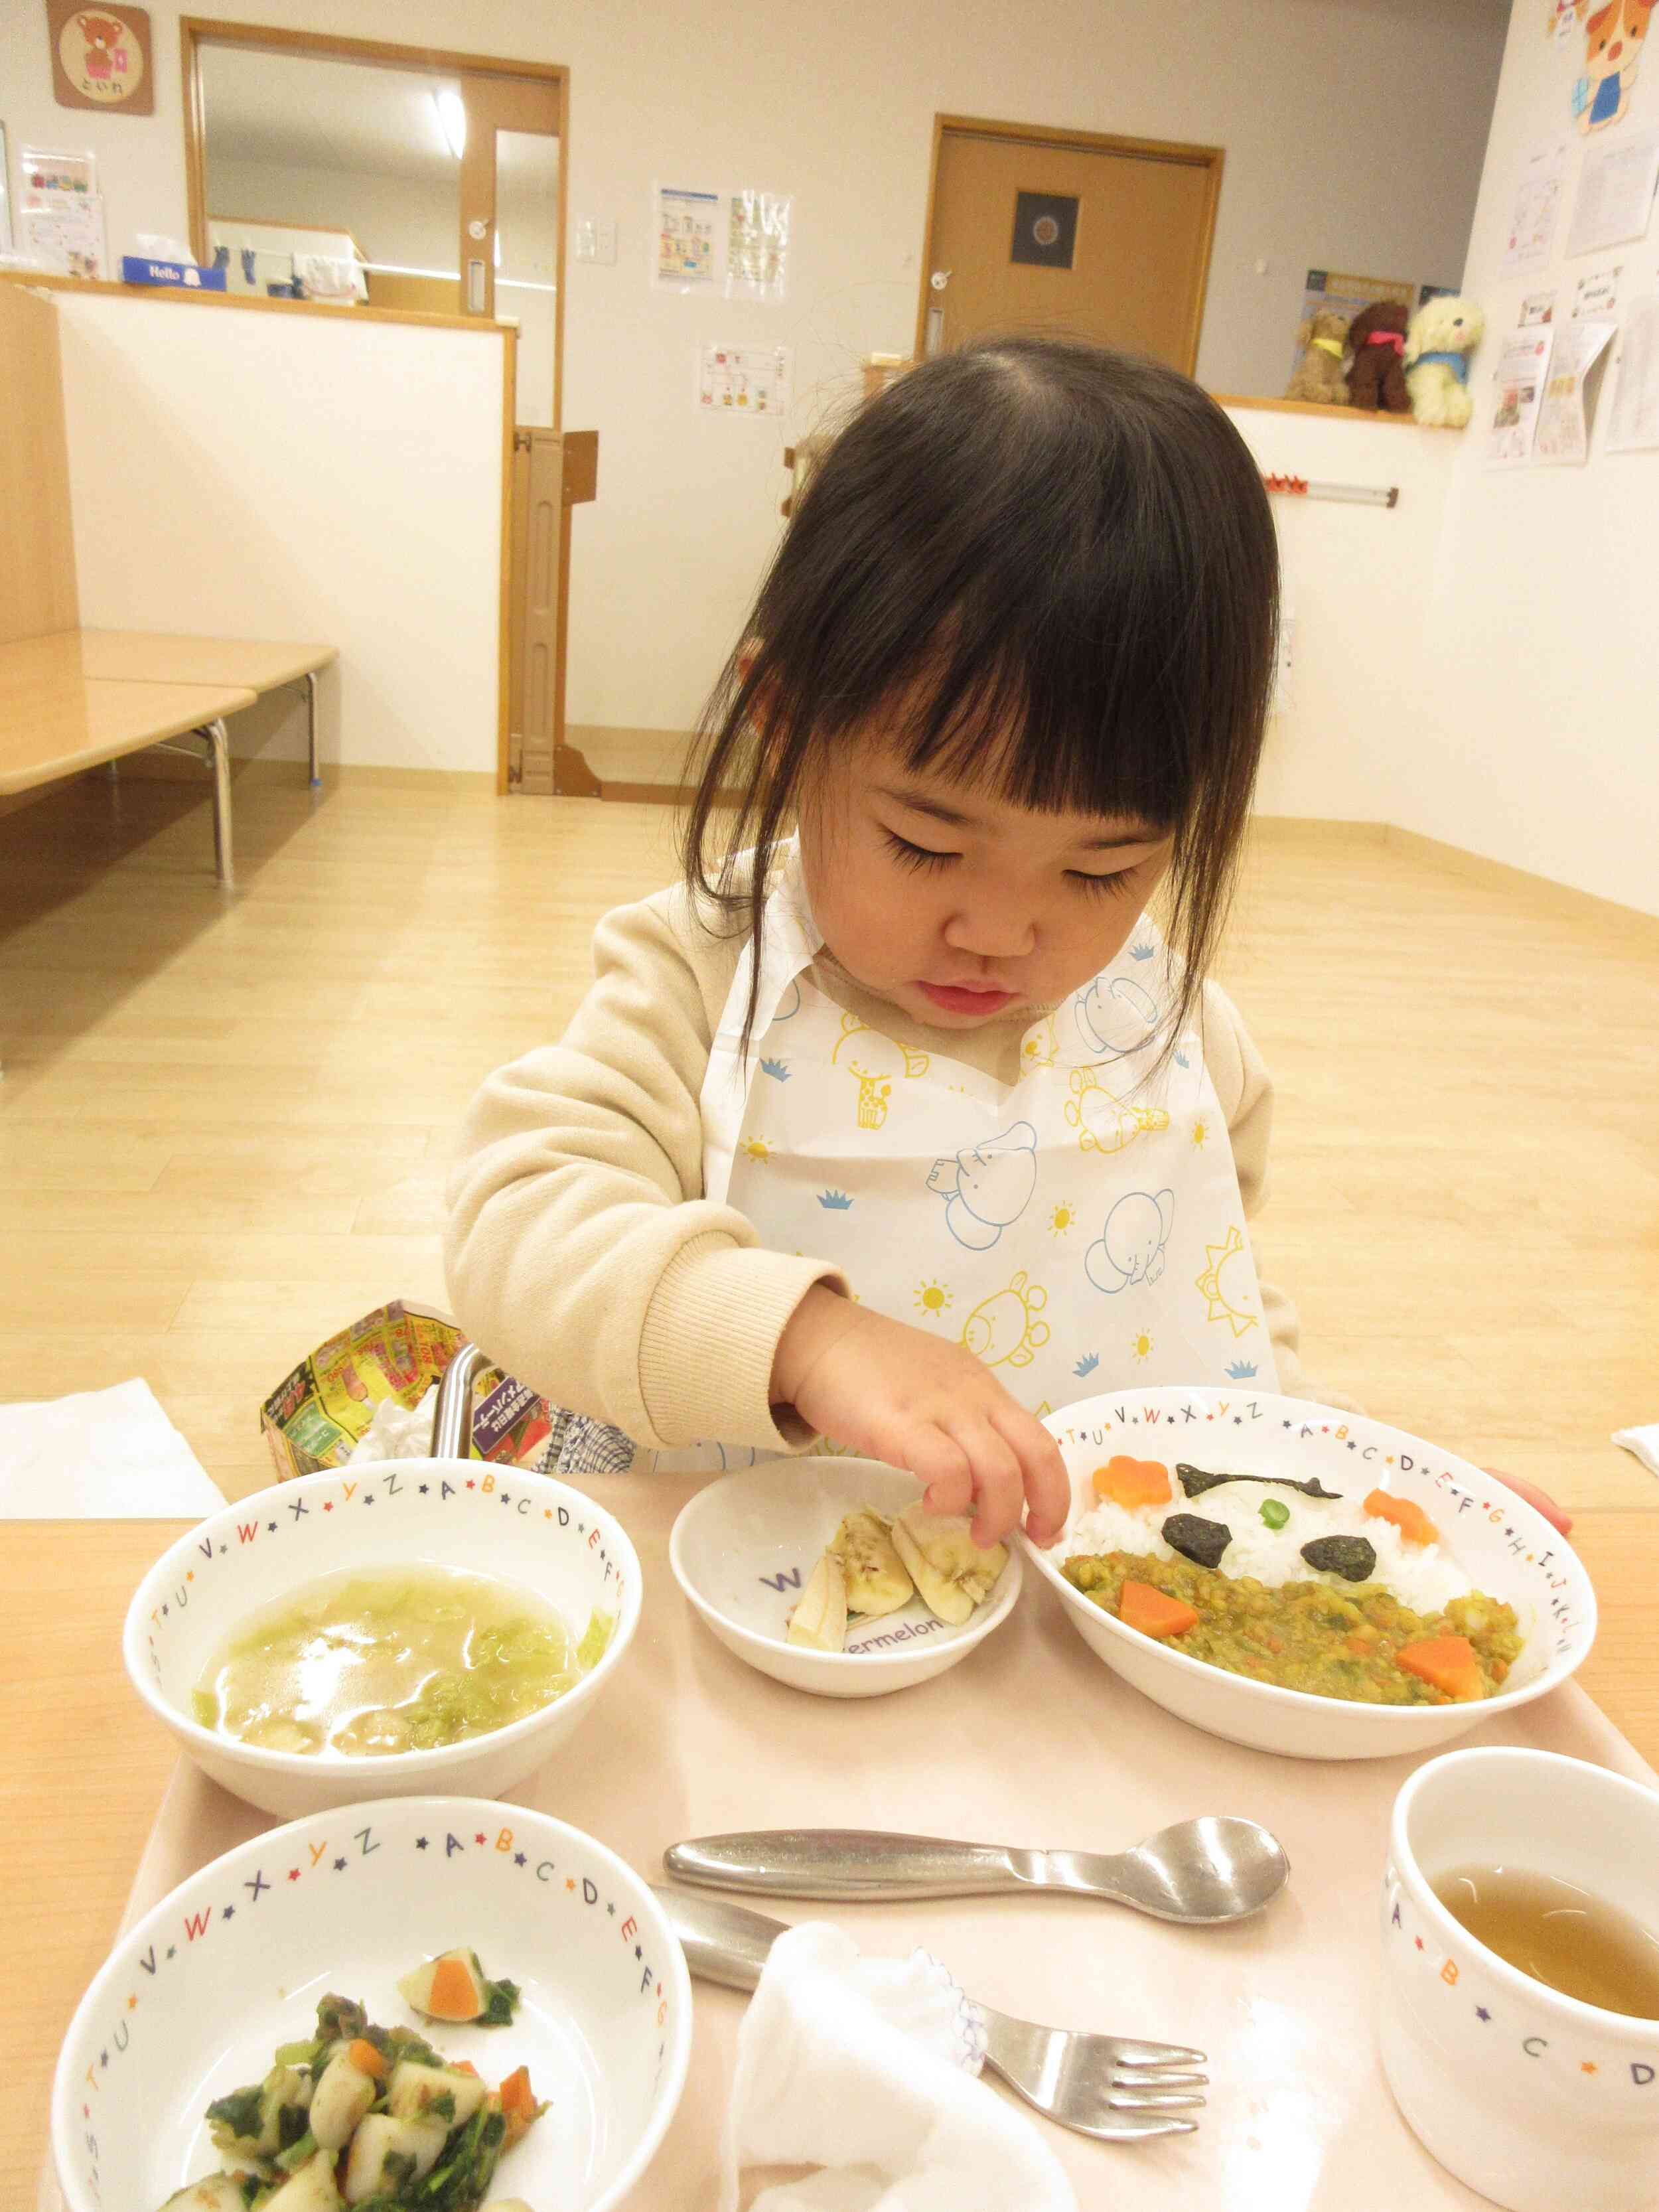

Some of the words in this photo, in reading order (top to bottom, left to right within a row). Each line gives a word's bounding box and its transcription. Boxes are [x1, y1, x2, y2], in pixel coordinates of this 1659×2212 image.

[149, 265, 180, 281] Hello
[176, 1585, 187, 1607] U
[199, 1538, 212, 1558] V
[237, 1521, 258, 1544] W
[289, 1497, 309, 1521] X
[383, 1473, 403, 1495] Z
[441, 1481, 455, 1501] A
[481, 1475, 495, 1493] B
[518, 1499, 531, 1514] C
[558, 1507, 569, 1526] D
[588, 1528, 601, 1550] E
[604, 1562, 613, 1582] F
[1066, 1428, 1075, 1444] T
[1092, 1430, 1103, 1445] U
[1115, 1406, 1125, 1423] V
[1143, 1406, 1161, 1424] W
[1181, 1405, 1197, 1423] X
[1246, 1402, 1263, 1420] Z
[1301, 1424, 1313, 1438] A
[1335, 1424, 1348, 1439] B
[1362, 1447, 1378, 1460] C
[1401, 1455, 1413, 1471] D
[1459, 1497, 1474, 1513] F
[1488, 1509, 1504, 1522] G
[1508, 1537, 1526, 1556] H
[758, 1567, 801, 1592] W
[844, 1617, 944, 1654] ermelon
[113, 2020, 129, 2052] U
[140, 1945, 155, 1975] V
[184, 1907, 211, 1942] W
[244, 1870, 271, 1902] X
[354, 1827, 380, 1855] Z
[446, 1832, 465, 1858] A
[495, 1827, 513, 1852] B
[537, 1862, 555, 1881] C
[583, 1878, 598, 1905] D
[621, 1916, 637, 1943] E
[640, 1965, 652, 1994] F
[1392, 1902, 1402, 1929] A
[1440, 1958, 1459, 1986] B
[1523, 2037, 1548, 2057] C
[1630, 2062, 1656, 2085] D
